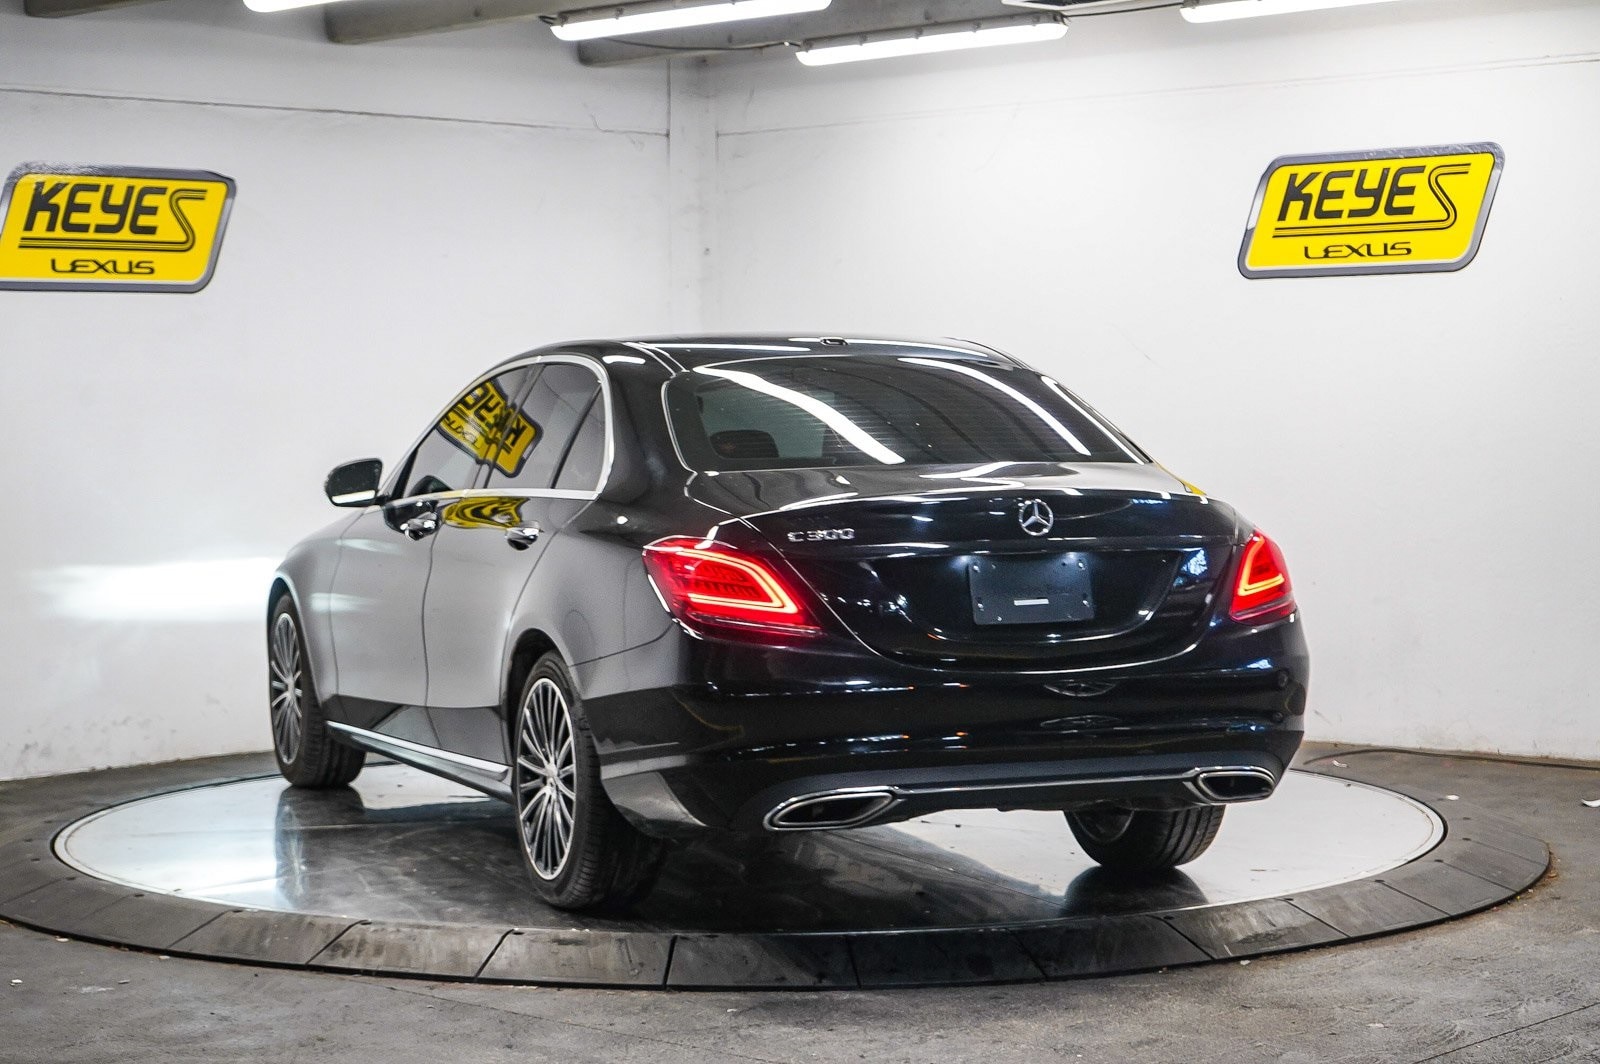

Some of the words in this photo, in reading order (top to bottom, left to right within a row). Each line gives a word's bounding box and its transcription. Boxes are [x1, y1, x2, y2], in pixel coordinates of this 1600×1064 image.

[1275, 163, 1471, 232] KEYES
[21, 181, 207, 251] KEYES
[1304, 242, 1412, 259] LEXUS
[51, 259, 155, 274] LEXUS
[787, 532, 804, 542] C
[806, 528, 855, 541] 300
